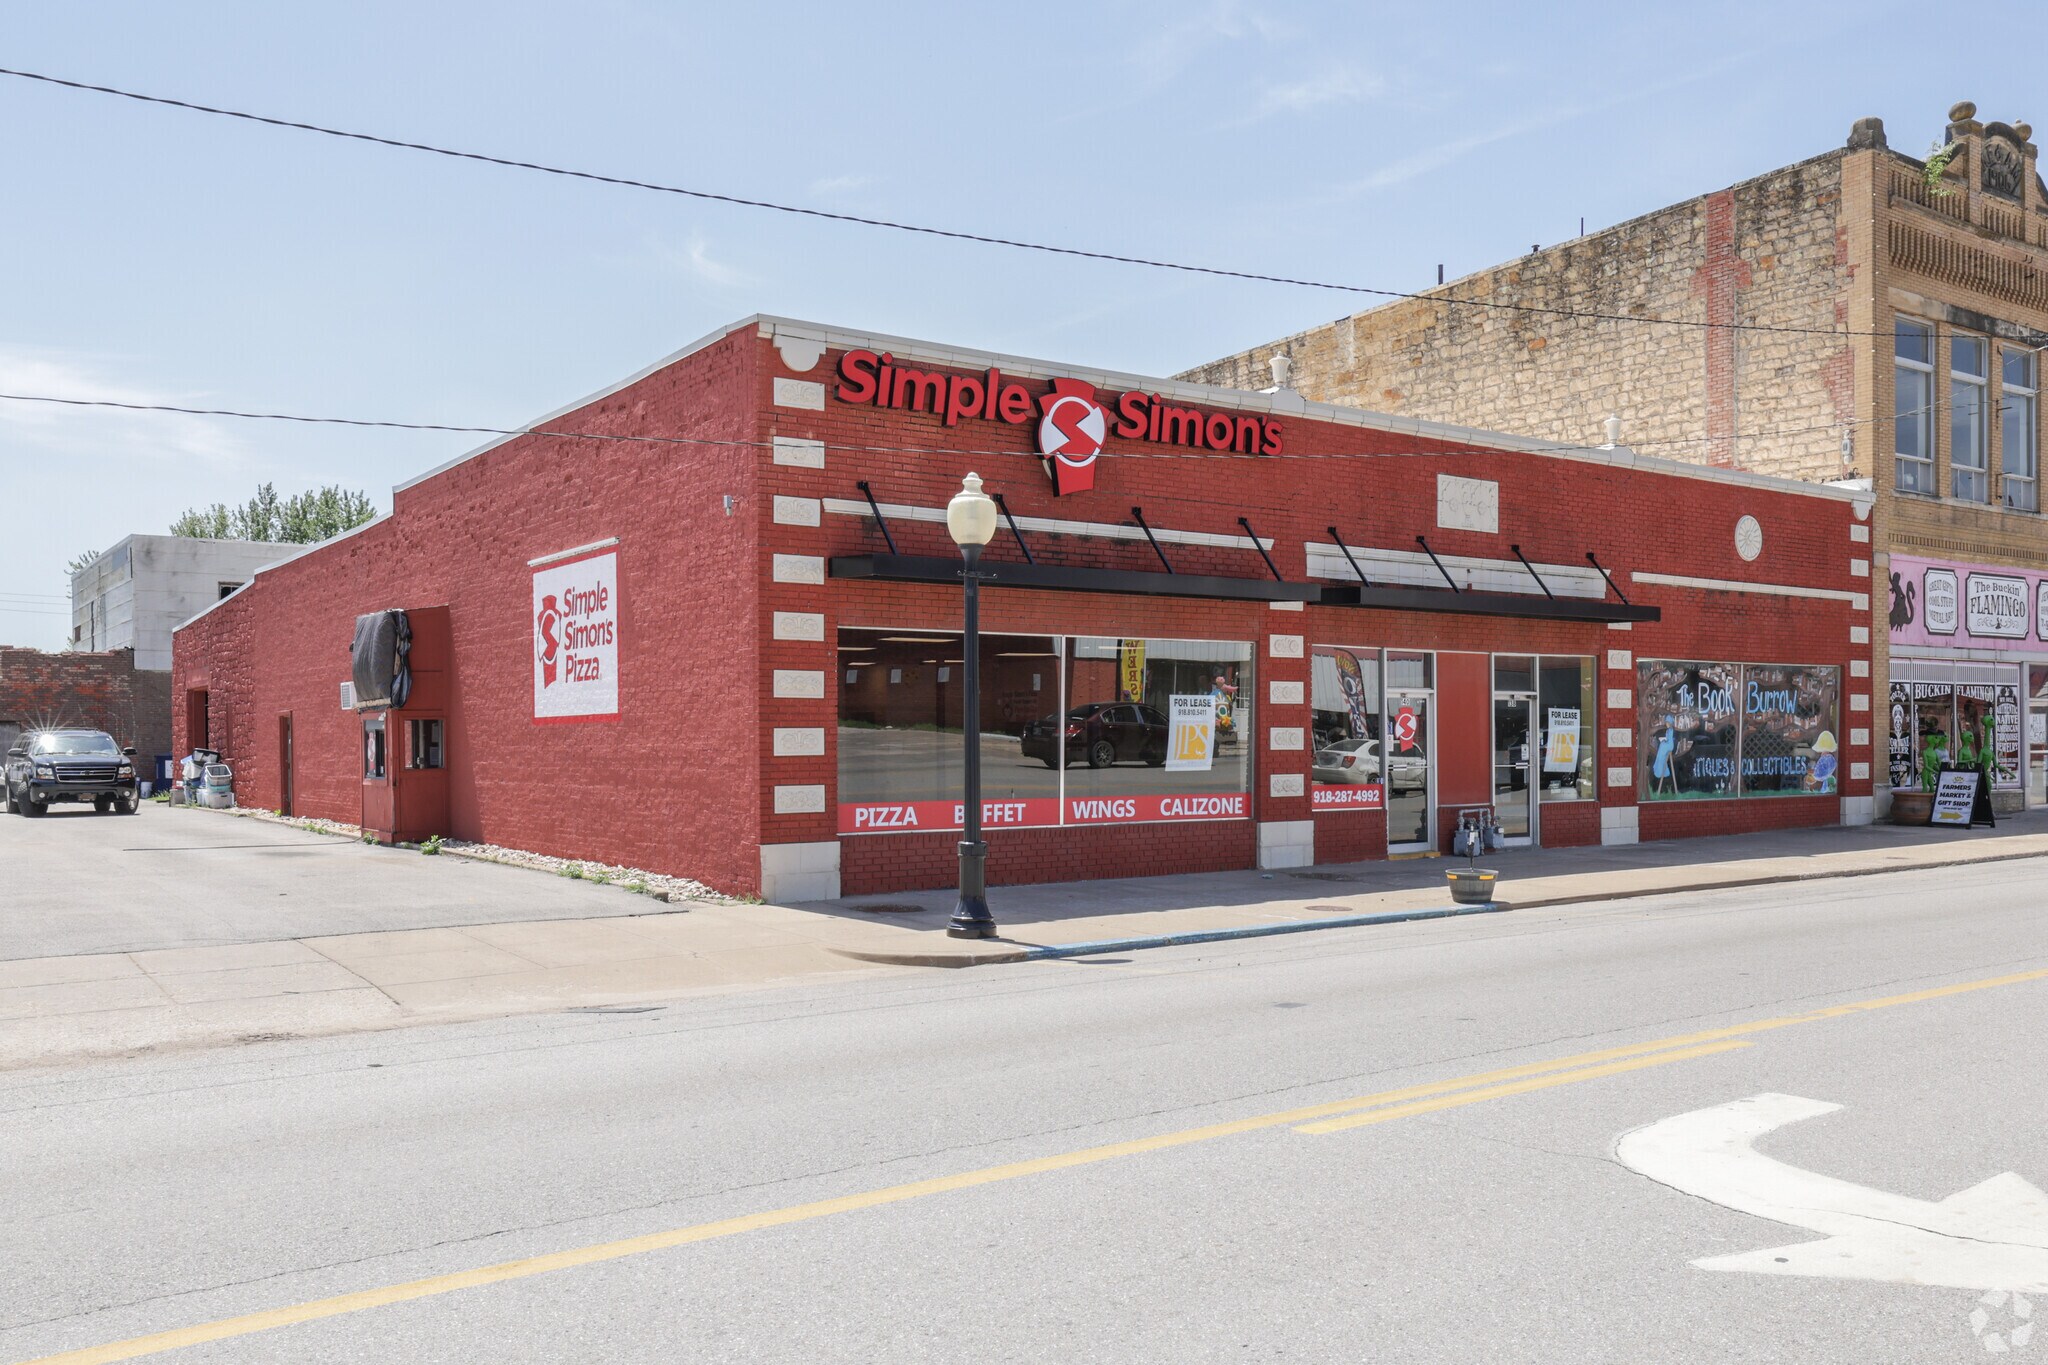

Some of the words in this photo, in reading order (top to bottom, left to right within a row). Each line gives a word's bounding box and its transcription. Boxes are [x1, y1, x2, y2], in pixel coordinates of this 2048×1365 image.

[834, 349, 1031, 427] Simple
[1111, 391, 1284, 456] Simon's
[563, 580, 608, 619] Simple
[1974, 581, 1990, 593] The
[1992, 583, 2022, 597] Buckin'
[1970, 594, 2026, 618] FLAMINGO
[564, 619, 613, 651] Simon's
[565, 653, 600, 683] Pizza
[1174, 698, 1188, 707] FOR
[1190, 698, 1211, 707] LEASE
[1676, 684, 1694, 707] The
[1698, 677, 1735, 714] Book
[1746, 681, 1798, 714] Burrow
[1914, 683, 1951, 700] BUCKIN
[1956, 685, 1994, 703] FLAMINGO
[1551, 711, 1561, 719] FOR
[1562, 711, 1578, 720] LEASE
[1997, 715, 2018, 724] NATIVE
[1742, 756, 1807, 776] COLLECTIBLES
[1313, 790, 1380, 803] 918-287-4992
[855, 806, 918, 827] PIZZA
[954, 803, 1026, 824] BFFET
[1072, 799, 1136, 819] WINGS
[1160, 797, 1243, 816] CALIZONE
